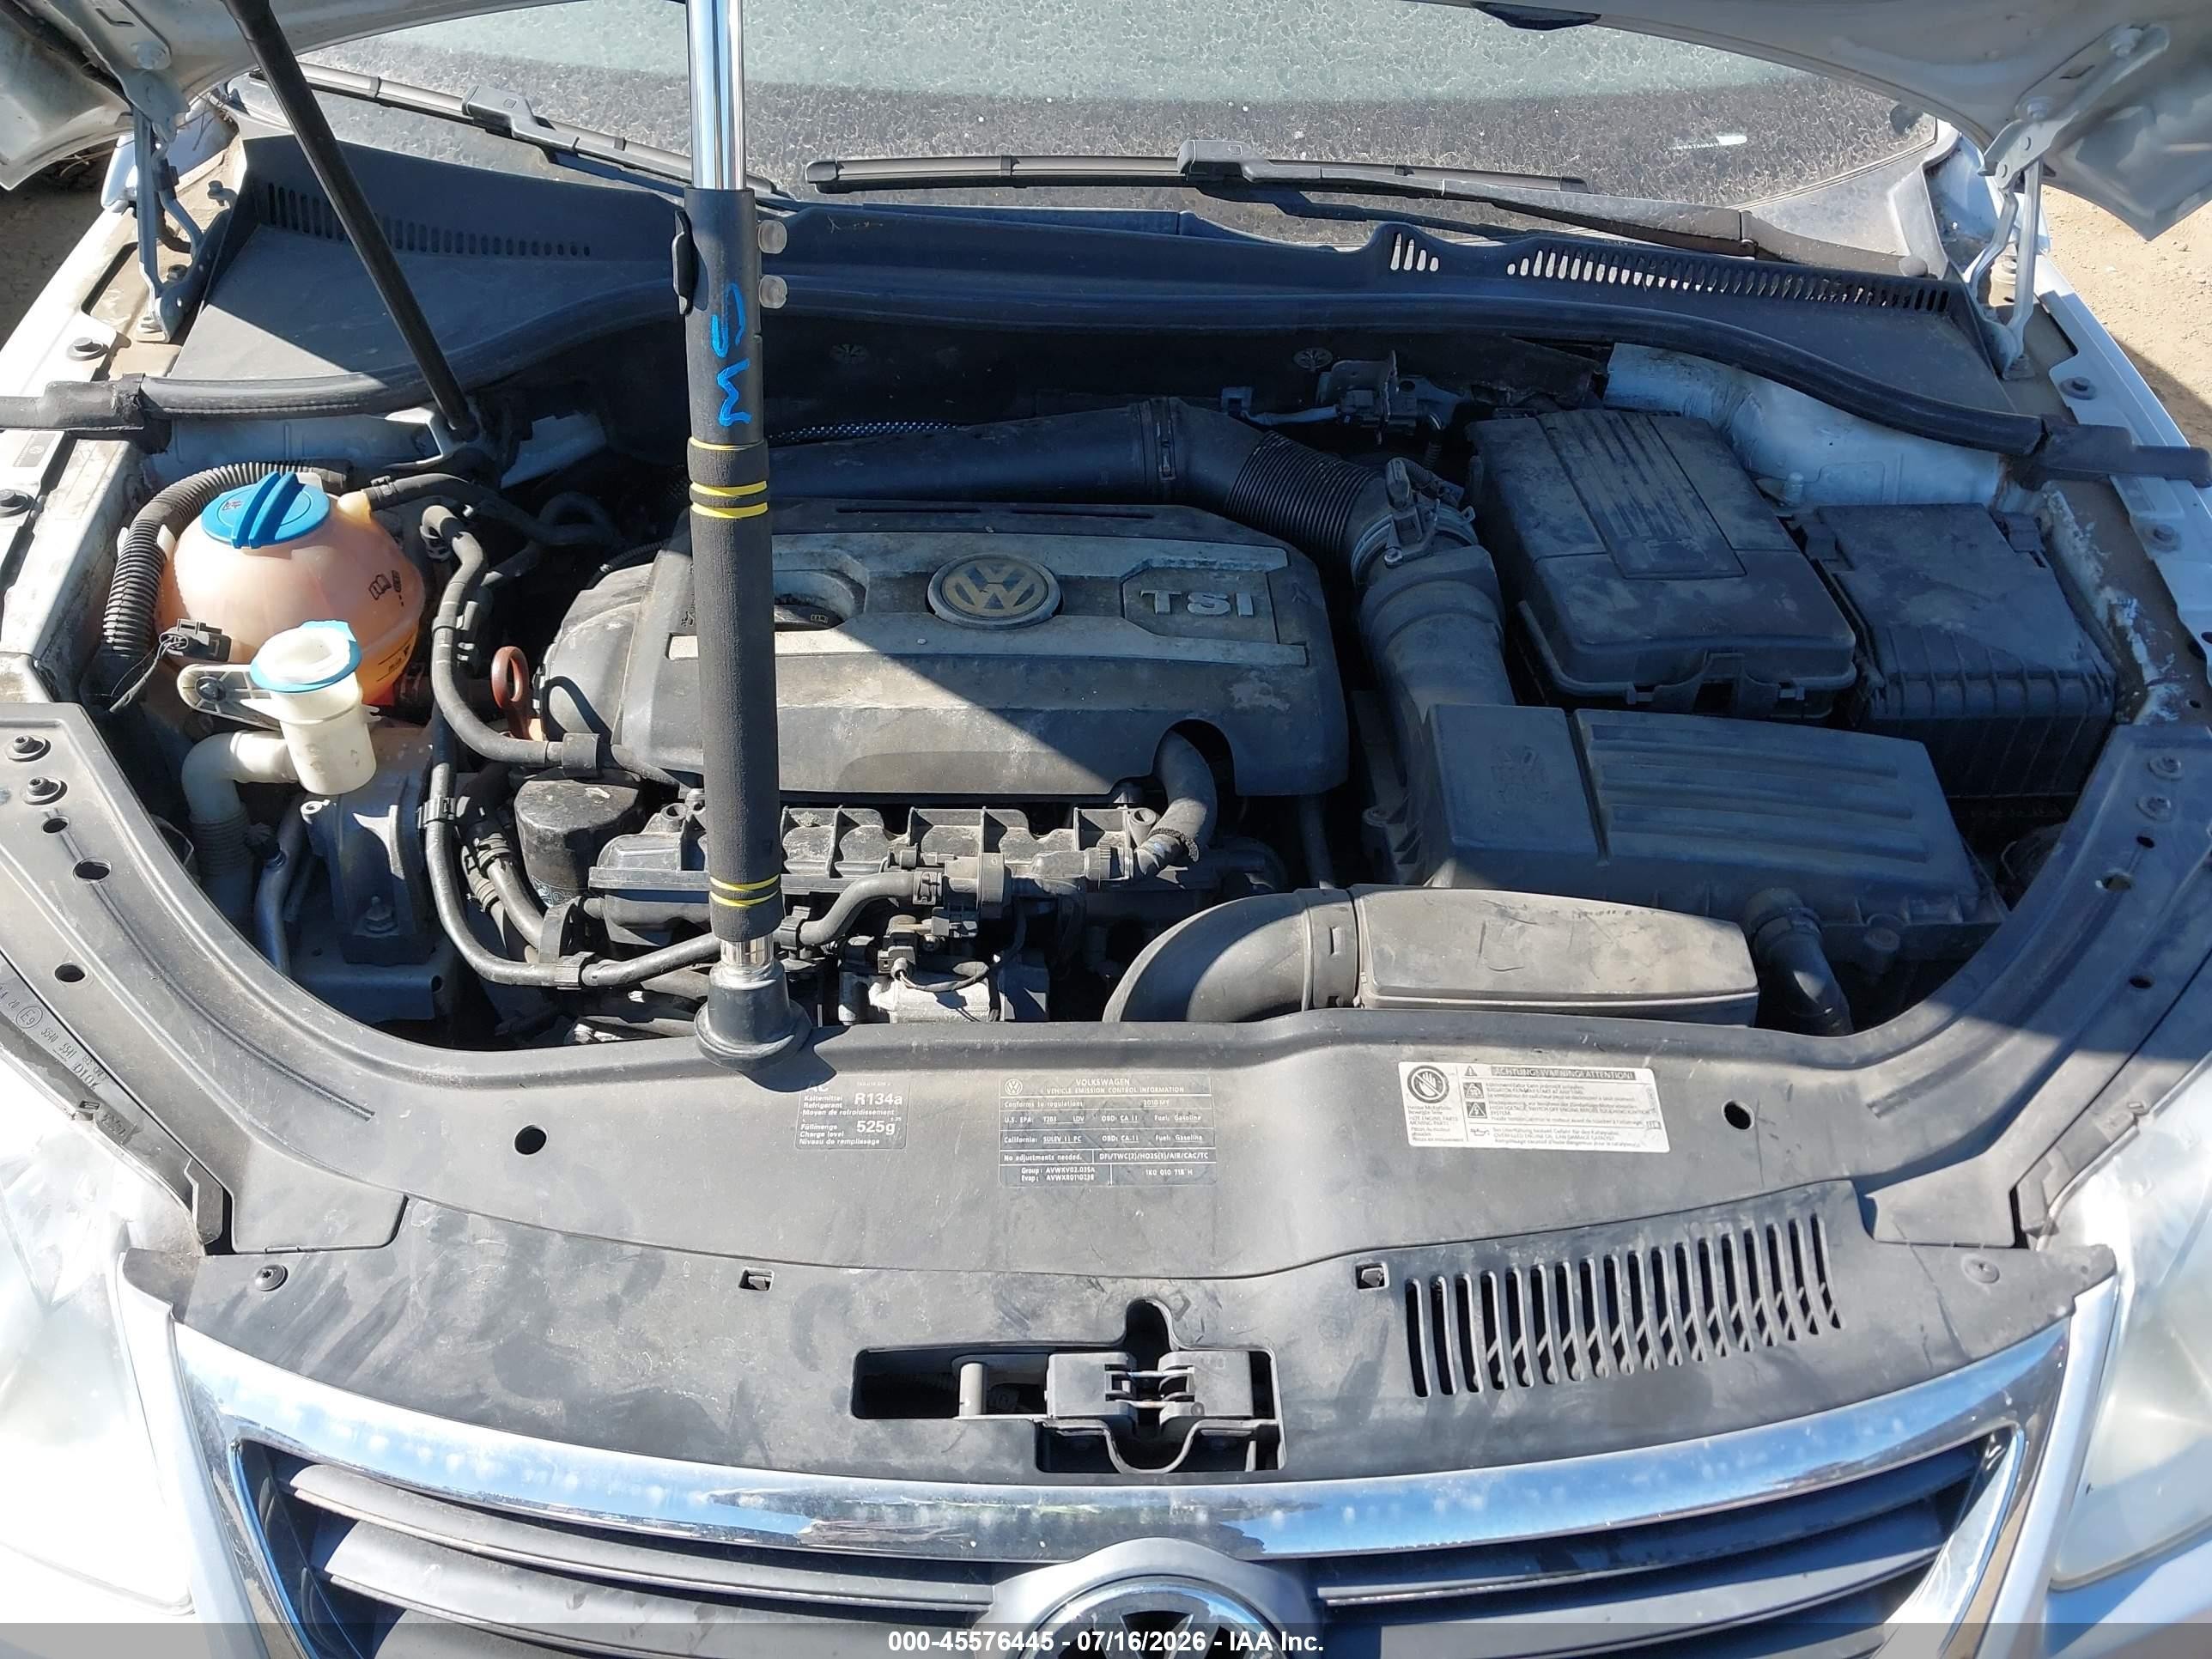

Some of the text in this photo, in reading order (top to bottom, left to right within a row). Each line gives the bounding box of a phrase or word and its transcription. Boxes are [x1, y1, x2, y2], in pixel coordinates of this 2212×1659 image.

[1139, 588, 1255, 617] TSI
[1075, 1078, 1130, 1086] VOLKSWAGEN
[854, 1092, 903, 1106] R134a
[856, 1120, 896, 1135] 525g
[836, 1138, 880, 1146] remplissage
[1015, 1153, 1055, 1162] adjustments
